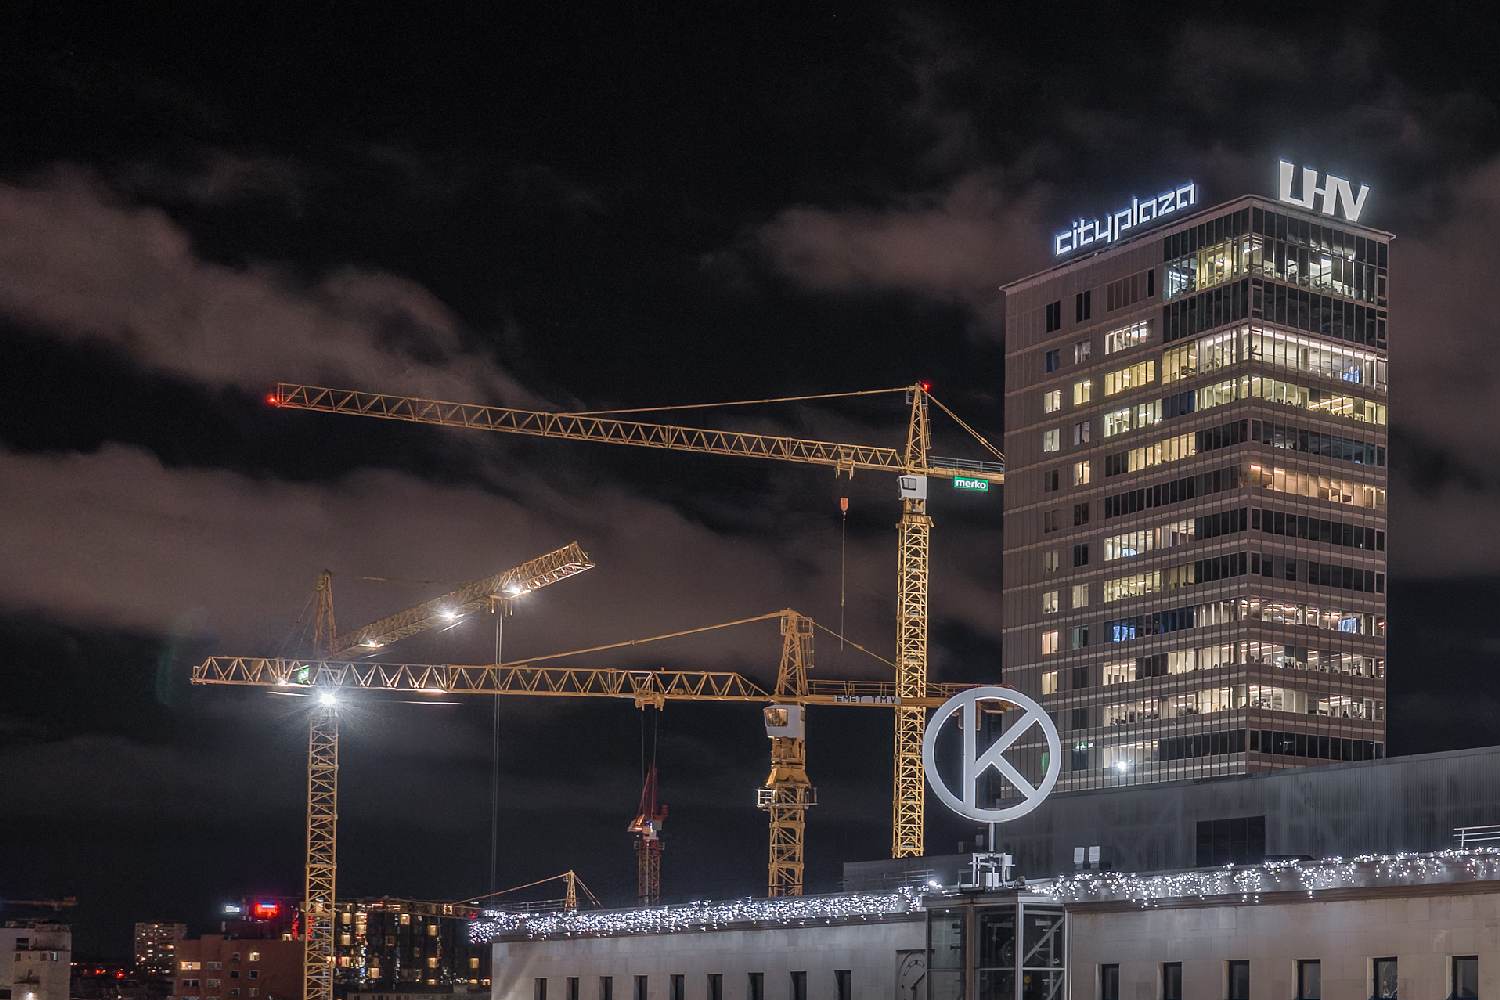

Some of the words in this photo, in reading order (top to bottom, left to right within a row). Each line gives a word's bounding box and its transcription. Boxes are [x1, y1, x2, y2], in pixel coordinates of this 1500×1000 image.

[1055, 182, 1196, 257] cityplaza
[1278, 160, 1370, 222] LHV
[955, 476, 987, 490] merko
